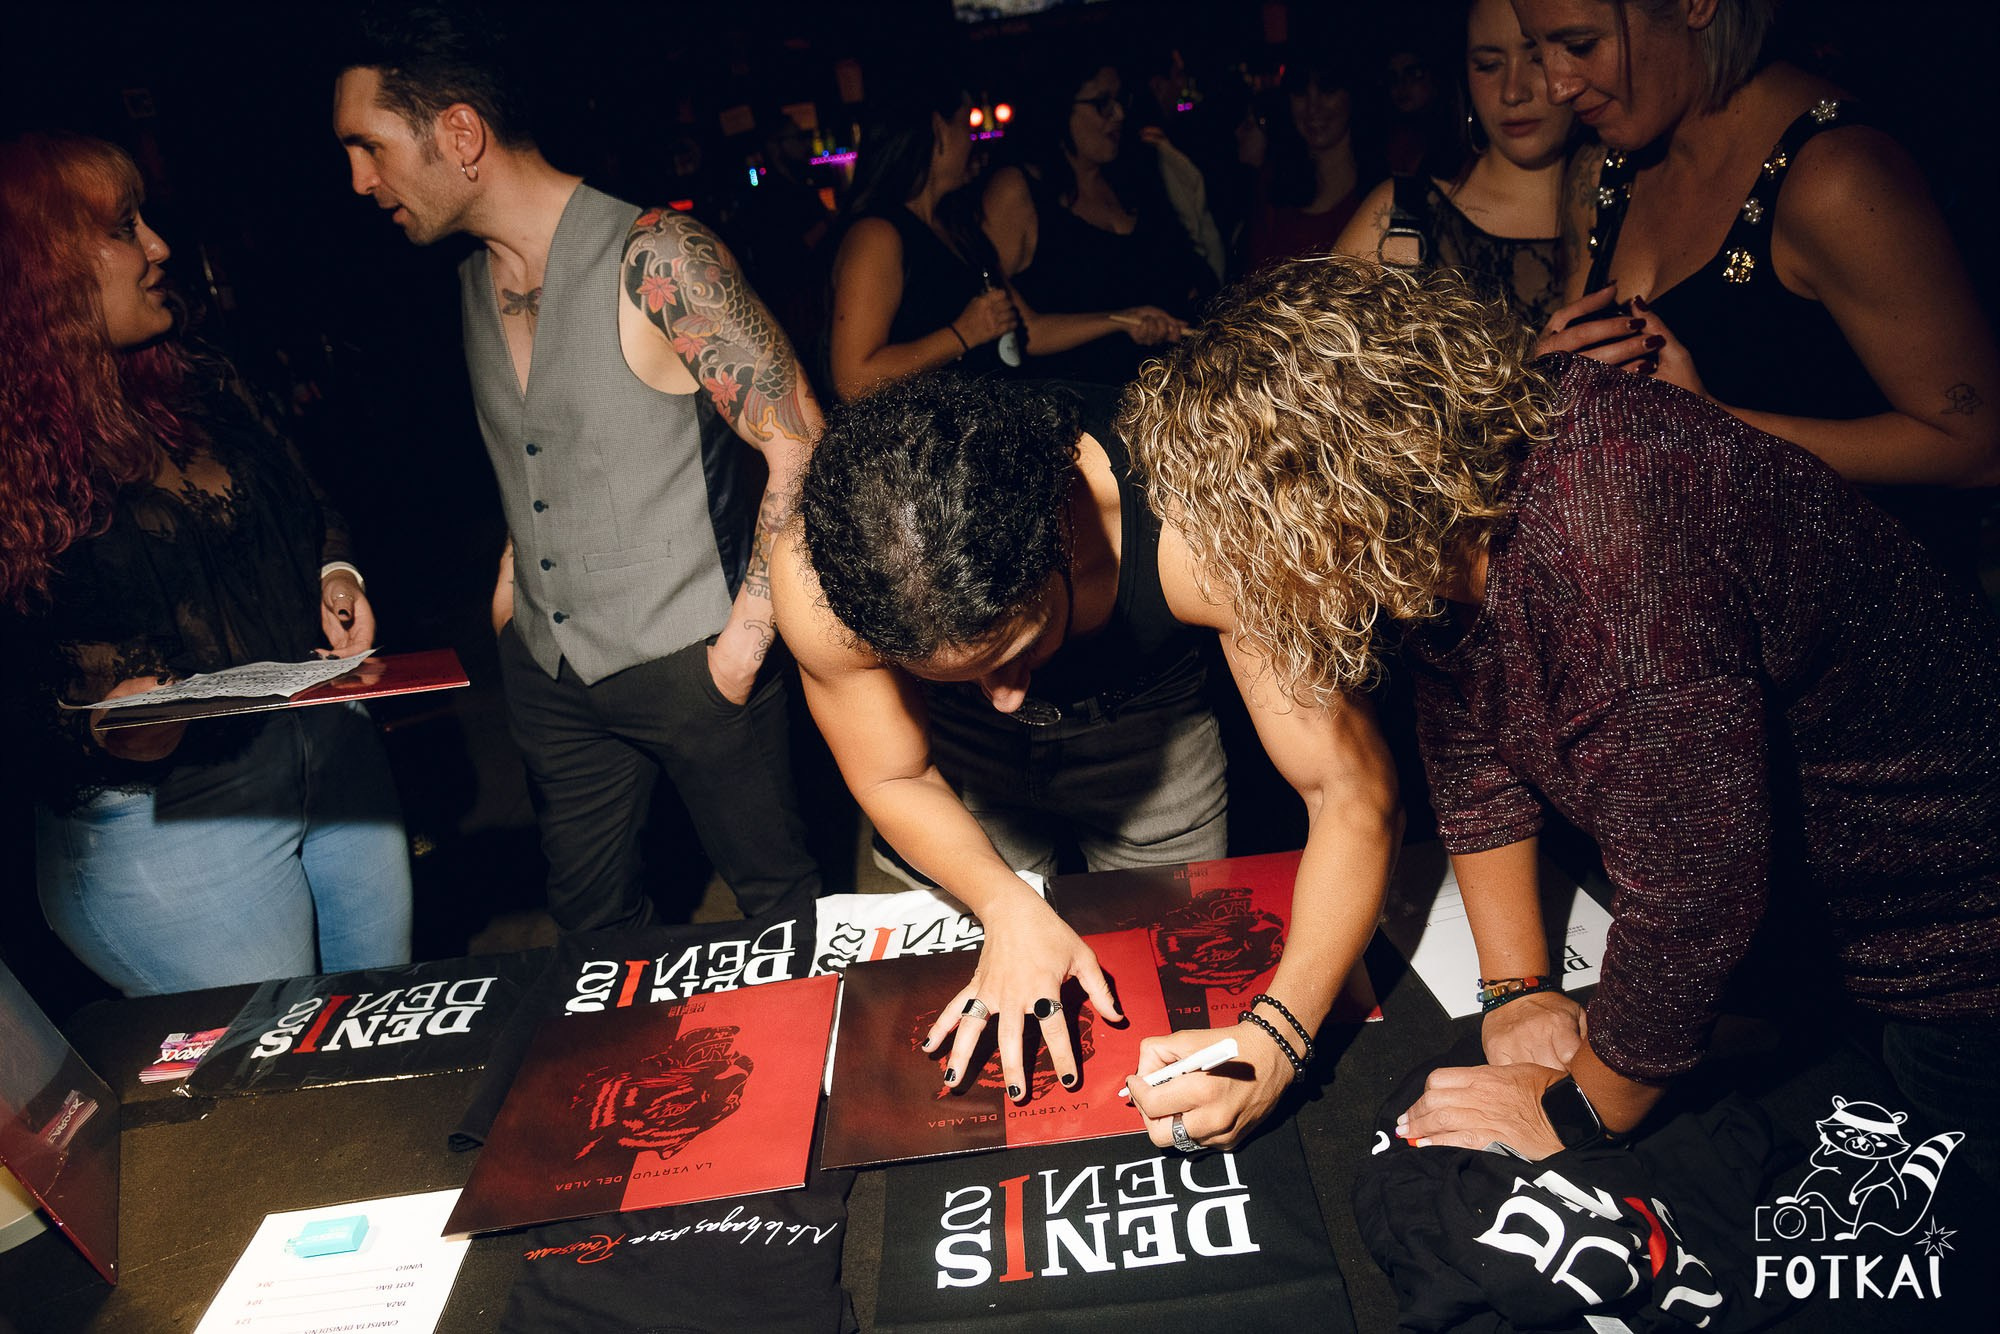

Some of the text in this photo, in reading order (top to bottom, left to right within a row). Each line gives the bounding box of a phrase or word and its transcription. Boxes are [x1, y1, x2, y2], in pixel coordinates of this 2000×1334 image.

[829, 912, 985, 955] ENIS
[277, 977, 499, 1031] DENIS
[250, 1006, 484, 1060] DENIS
[928, 1102, 1089, 1129] LA VIRTUD DEL ALBA
[555, 1162, 712, 1192] LA VIRTUD DEL ALBA
[940, 1152, 1248, 1232] DENIS
[694, 1205, 761, 1245] hagas
[786, 1222, 838, 1245] No
[934, 1193, 1261, 1289] DENIS
[395, 1263, 423, 1272] VINILO
[386, 1300, 407, 1308] TAZA
[355, 1320, 399, 1330] CAMISETA
